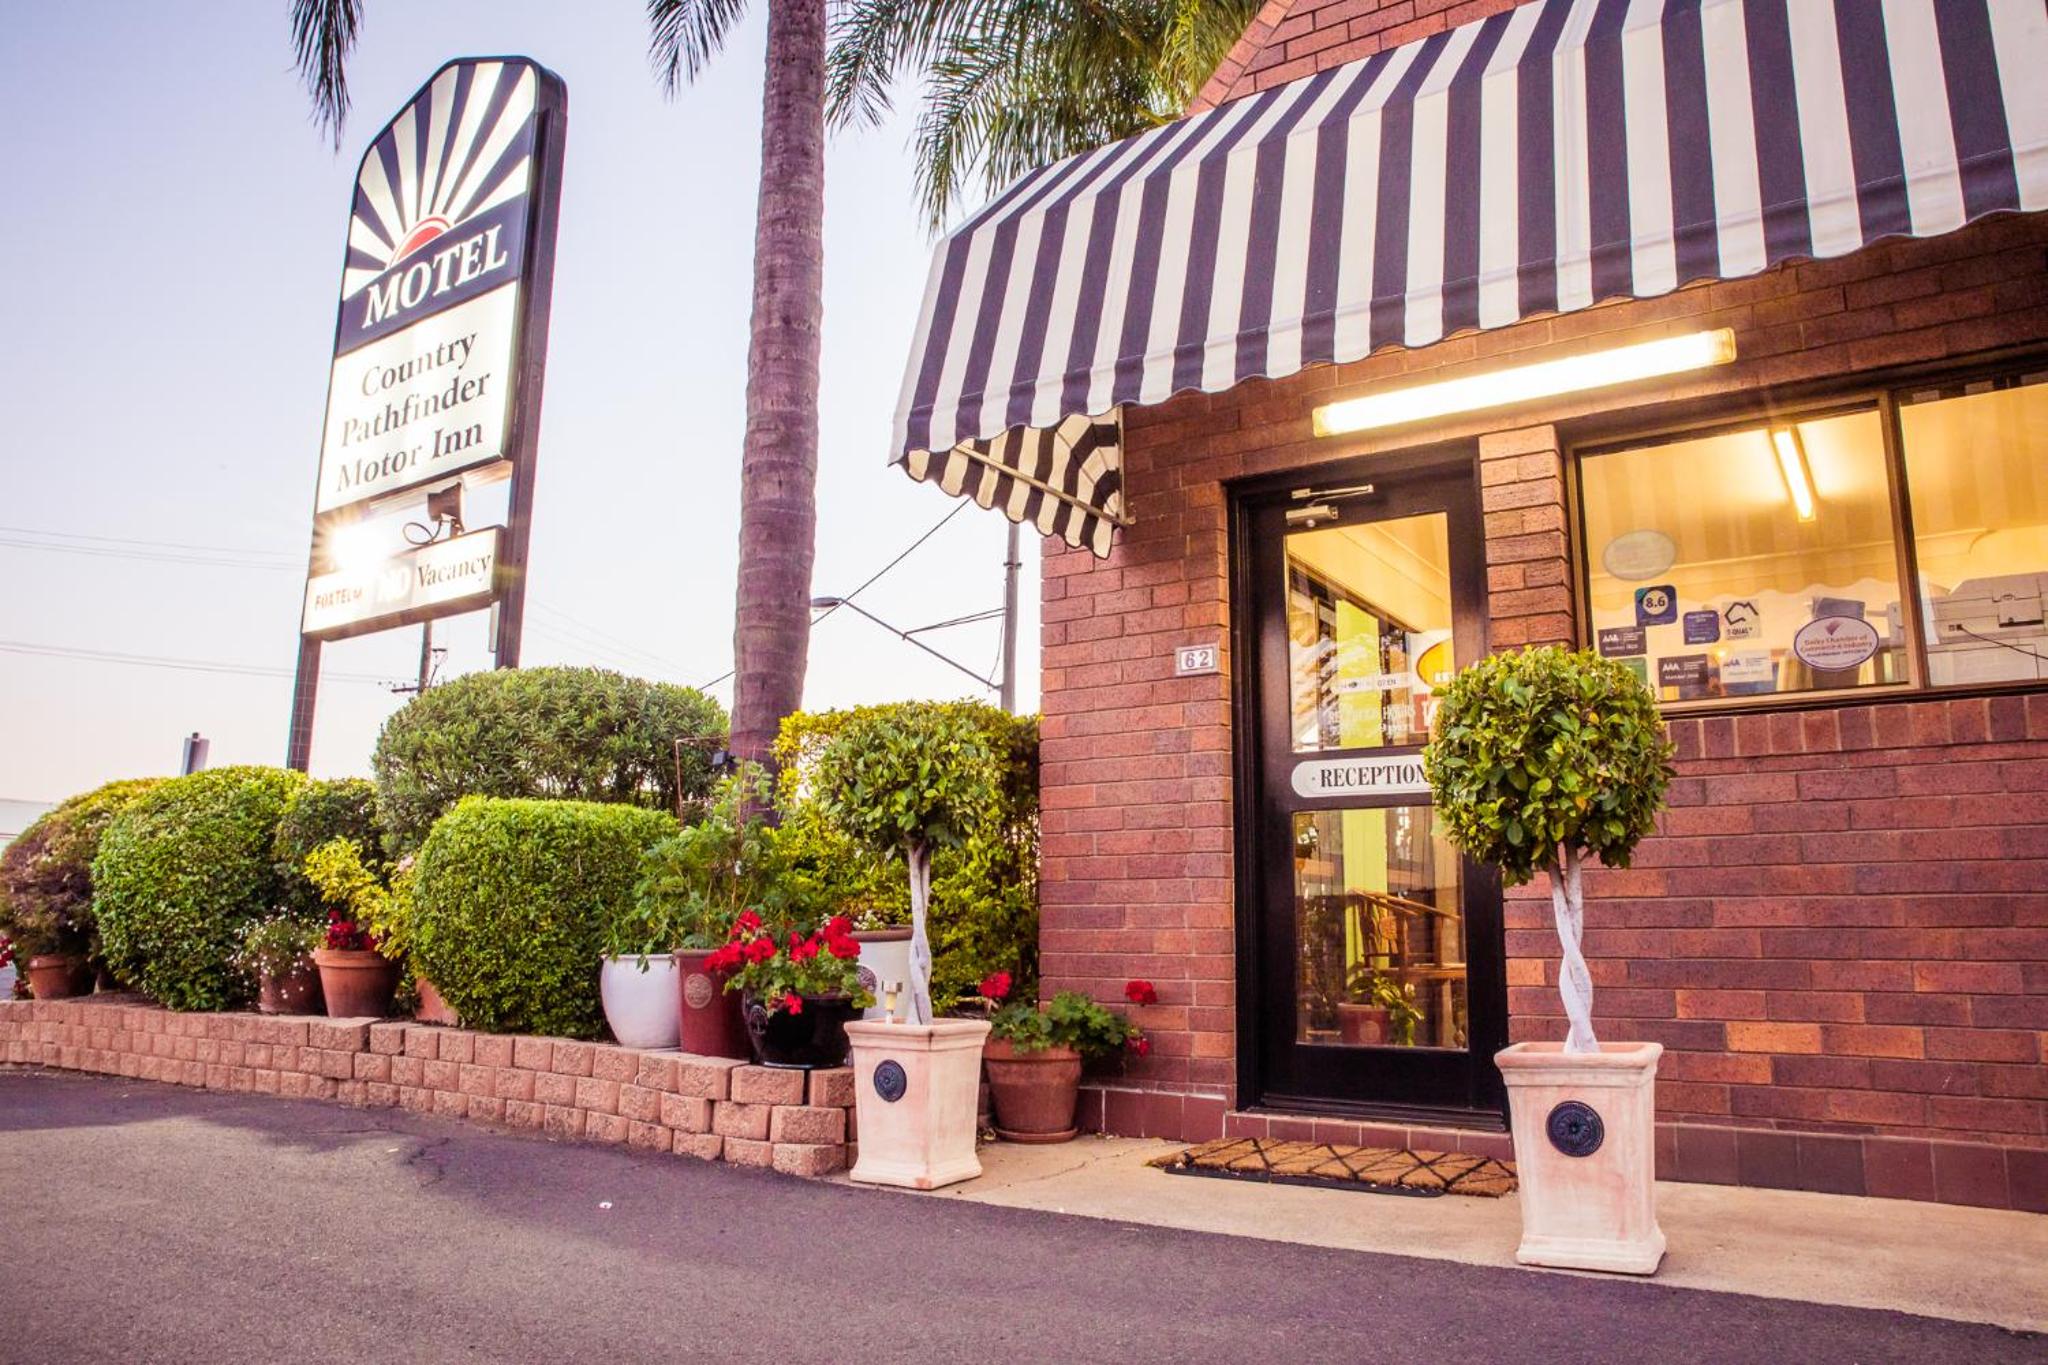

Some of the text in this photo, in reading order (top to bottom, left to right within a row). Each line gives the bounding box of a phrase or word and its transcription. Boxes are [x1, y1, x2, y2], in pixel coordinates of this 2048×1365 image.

[362, 224, 508, 329] MOTEL
[362, 333, 477, 397] Country
[341, 373, 491, 447] Pathfinder
[337, 423, 483, 492] Motor Inn
[418, 554, 491, 588] Vacancy
[1645, 596, 1665, 608] 8.6
[1185, 650, 1209, 668] 62
[1662, 662, 1680, 672] AAA
[1320, 763, 1429, 787] RECEPTION
